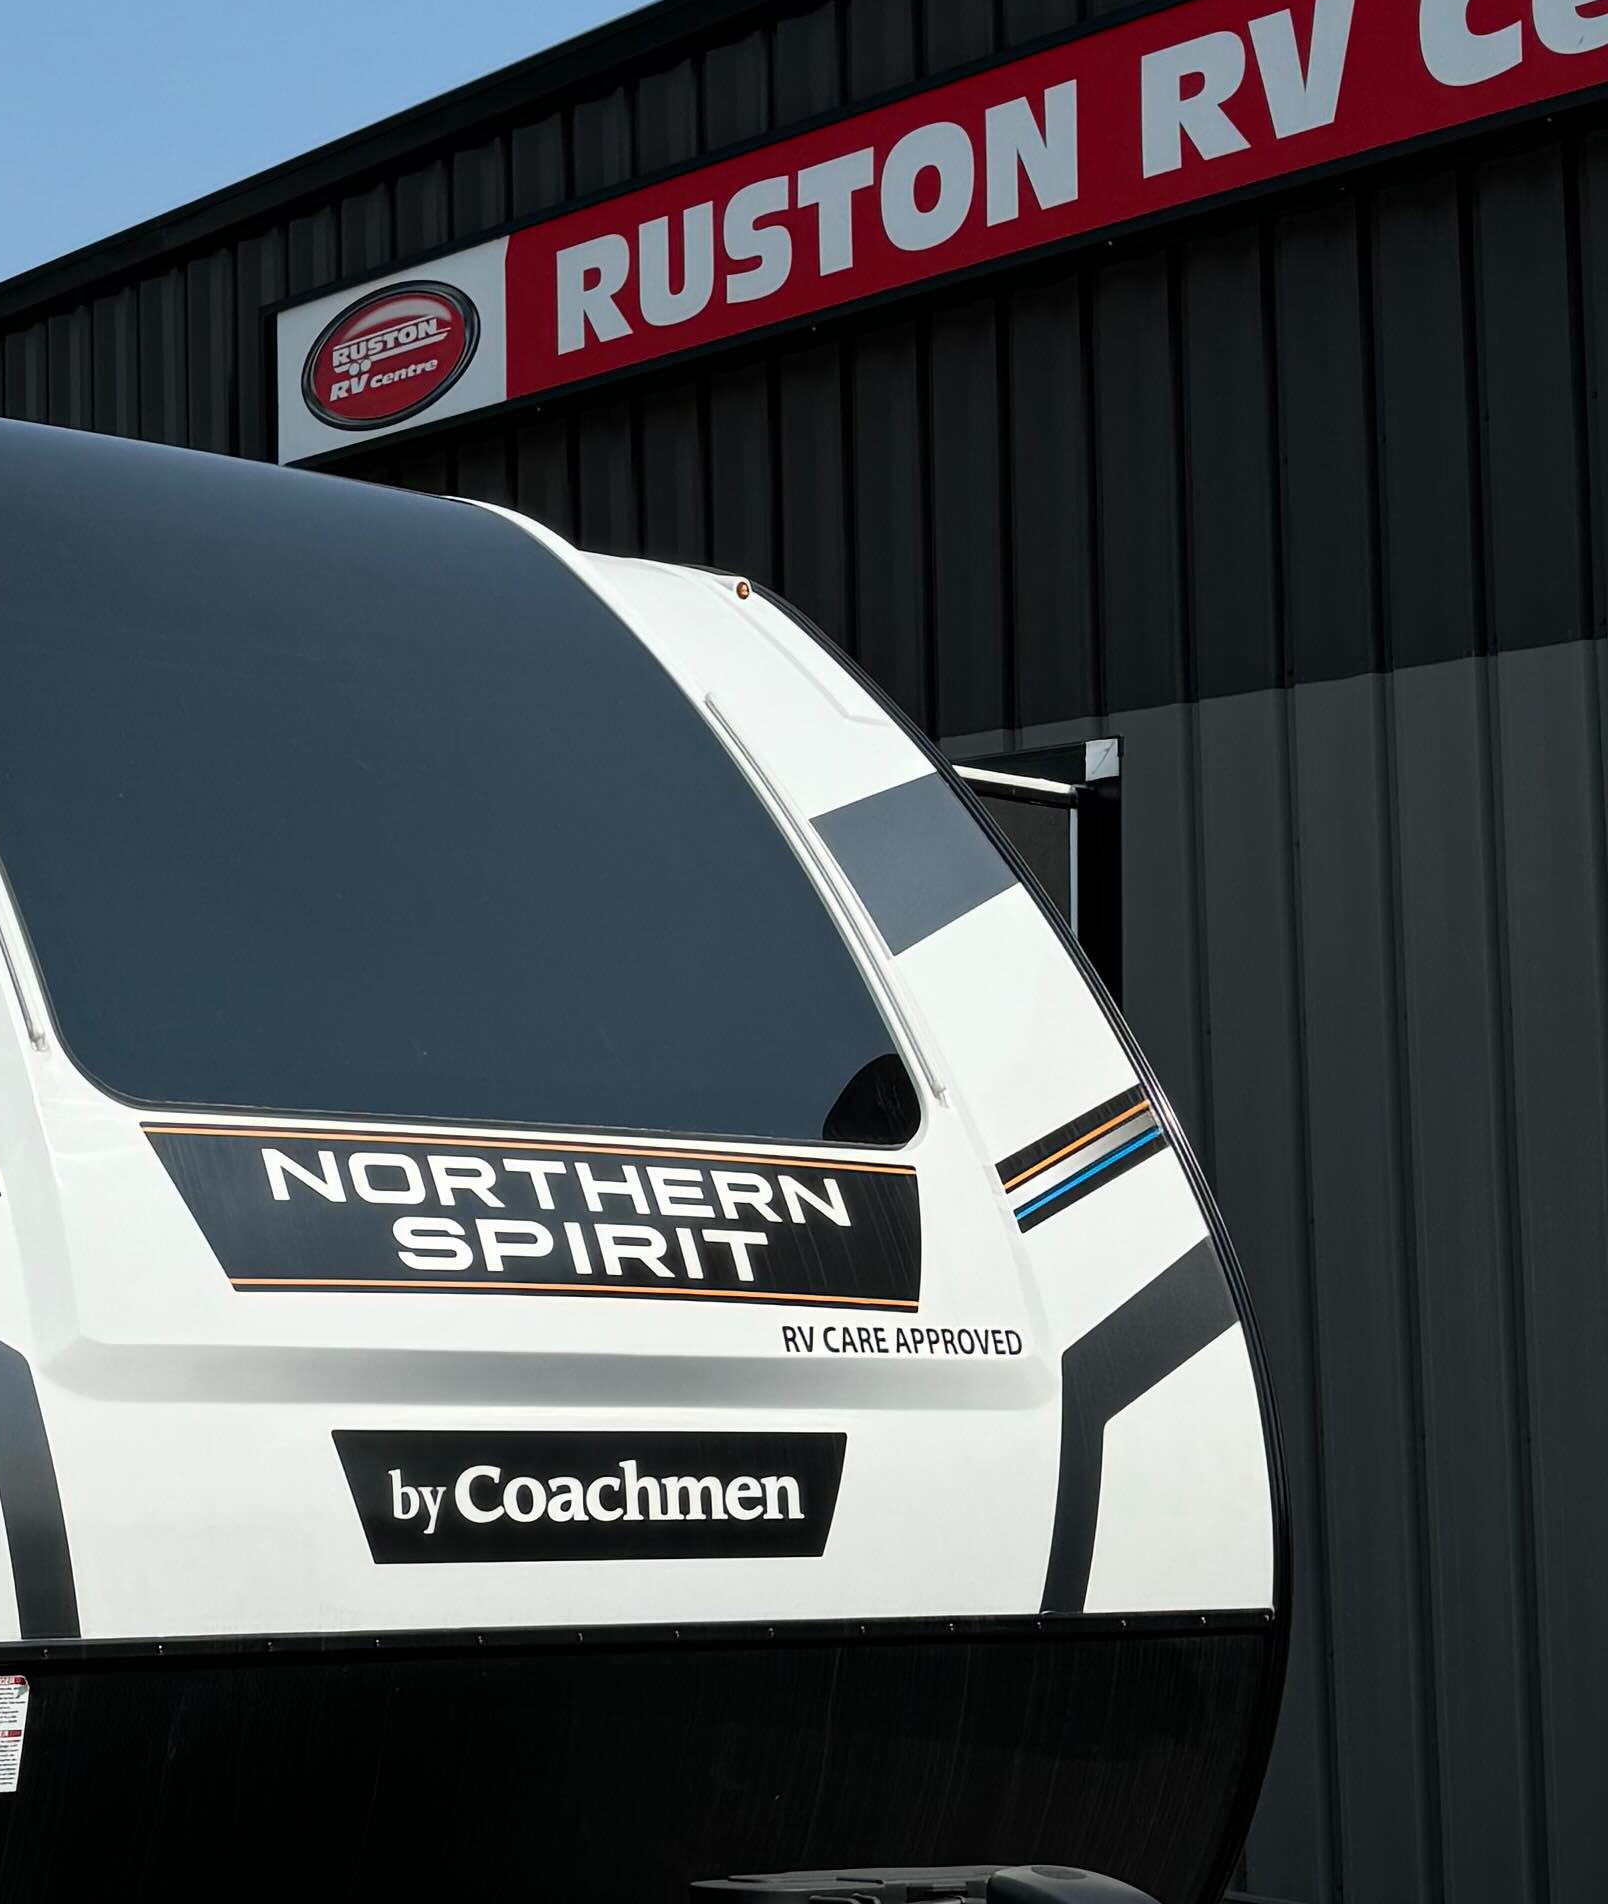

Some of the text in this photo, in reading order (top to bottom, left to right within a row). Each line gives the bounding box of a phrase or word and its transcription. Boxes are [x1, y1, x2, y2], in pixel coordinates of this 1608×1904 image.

[556, 79, 1079, 356] RUSTON
[332, 318, 438, 368] RUSTON
[330, 359, 438, 401] RV centre
[261, 1148, 852, 1227] NORTHERN
[392, 1217, 768, 1282] SPIRIT
[782, 1326, 1023, 1356] RV CARE APPROVED
[388, 1460, 805, 1534] by Coachmen
